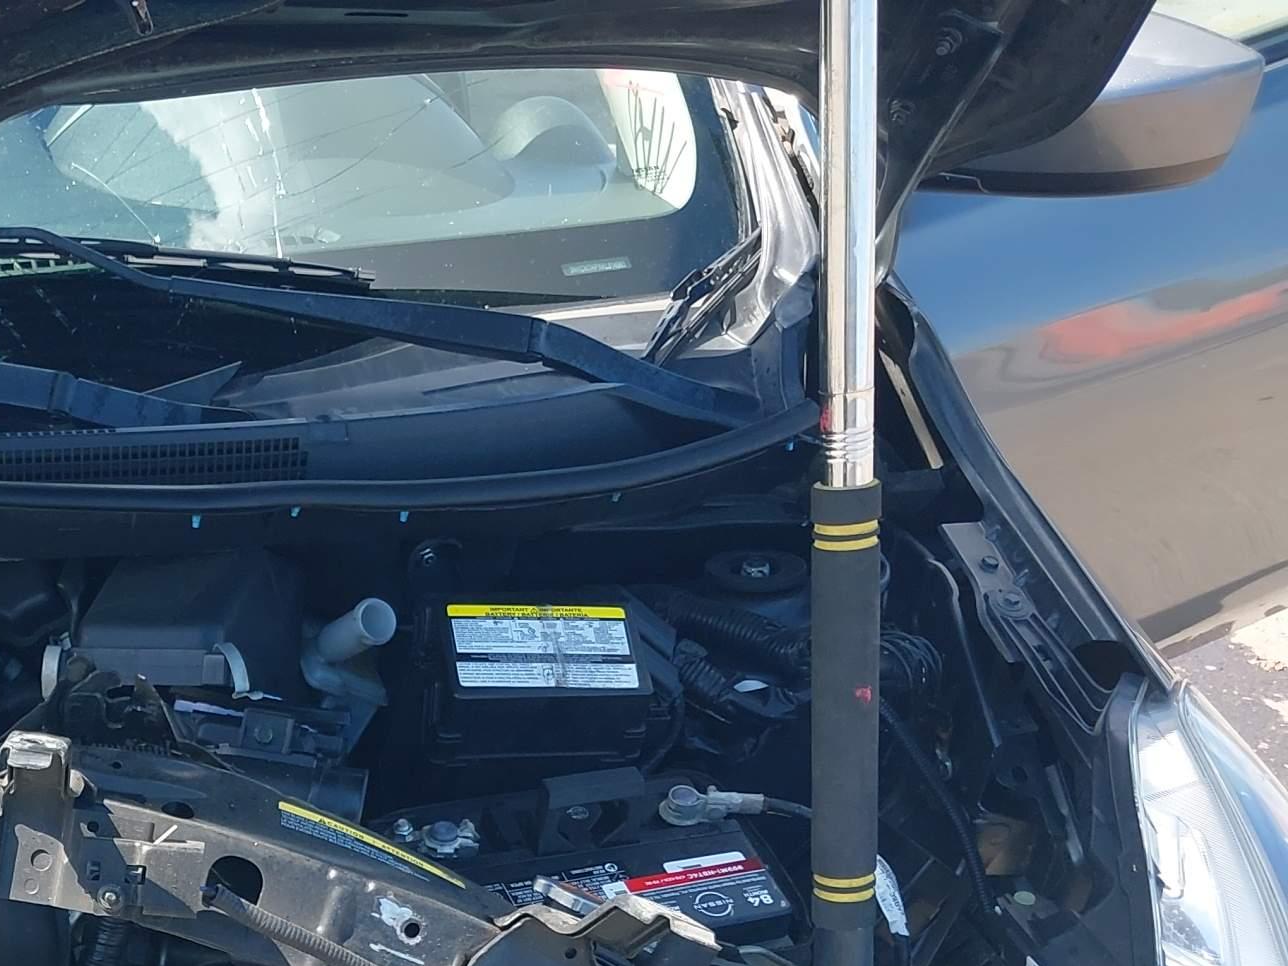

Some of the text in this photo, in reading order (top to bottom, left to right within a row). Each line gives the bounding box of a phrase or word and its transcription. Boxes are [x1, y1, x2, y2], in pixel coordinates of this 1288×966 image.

[327, 821, 365, 840] CAUTION
[743, 889, 768, 898] MONTH
[694, 898, 735, 911] NISSAN
[749, 894, 773, 906] 84
